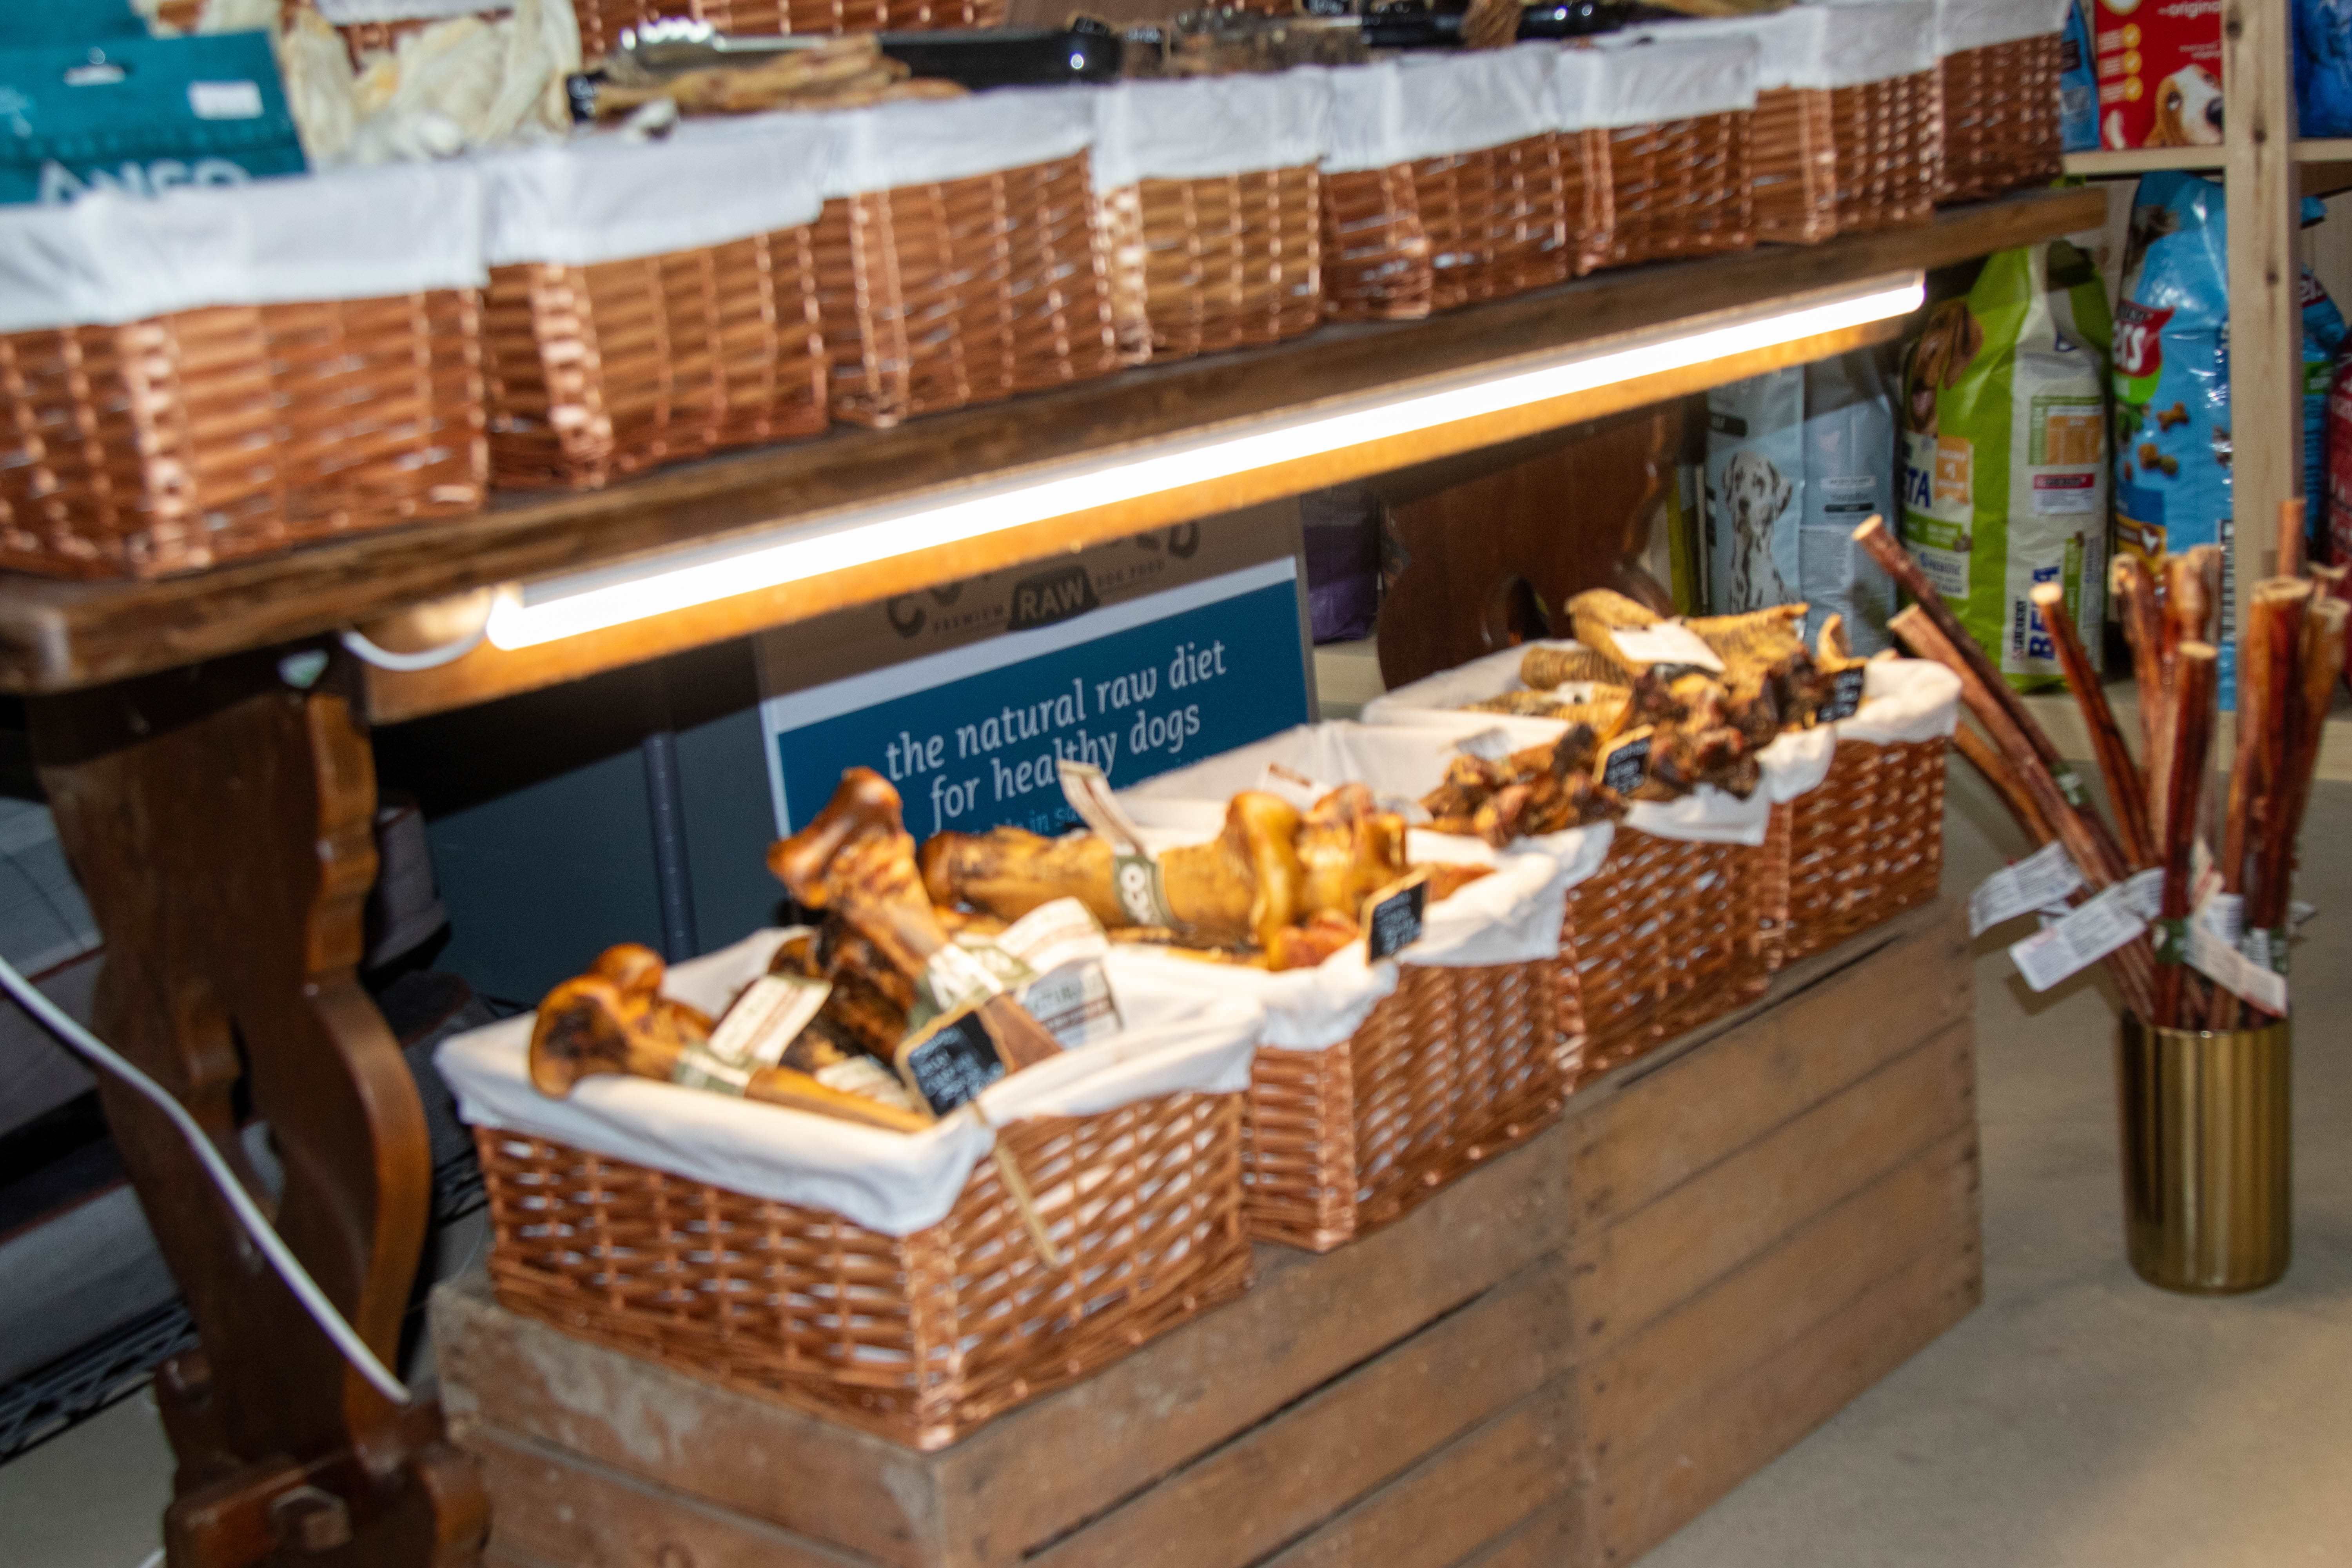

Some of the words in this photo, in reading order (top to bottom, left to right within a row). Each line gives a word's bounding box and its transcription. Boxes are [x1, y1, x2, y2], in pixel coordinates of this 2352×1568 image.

[1020, 575, 1085, 622] RAW
[886, 731, 945, 781] the
[955, 677, 1087, 760] natural
[1095, 667, 1158, 713] raw
[1169, 640, 1227, 690] diet
[929, 775, 980, 835] for
[991, 729, 1118, 802] healthy
[1129, 704, 1201, 754] dogs
